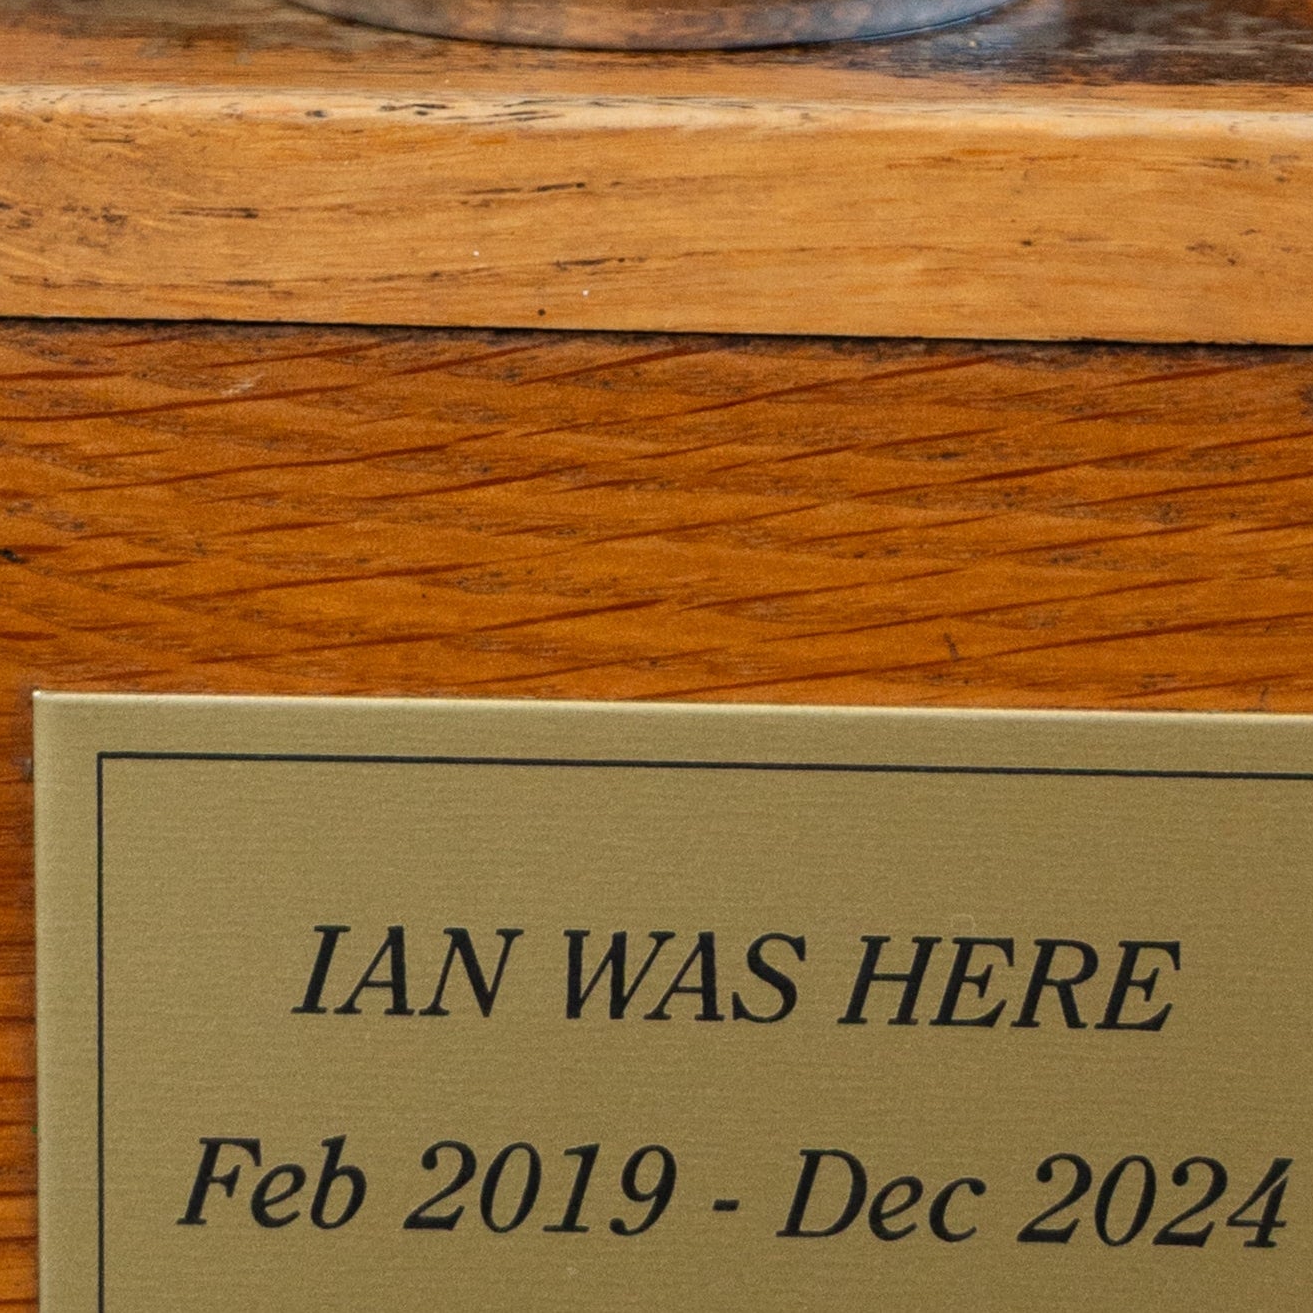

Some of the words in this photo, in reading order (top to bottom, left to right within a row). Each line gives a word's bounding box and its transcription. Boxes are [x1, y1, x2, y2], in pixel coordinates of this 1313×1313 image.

[291, 924, 523, 1019] IAN
[560, 929, 807, 1025] WAS
[837, 935, 1182, 1032] HERE
[176, 1134, 368, 1230] Feb
[403, 1138, 679, 1236] 2019
[775, 1148, 987, 1243] Dec
[1016, 1151, 1294, 1250] 2024
